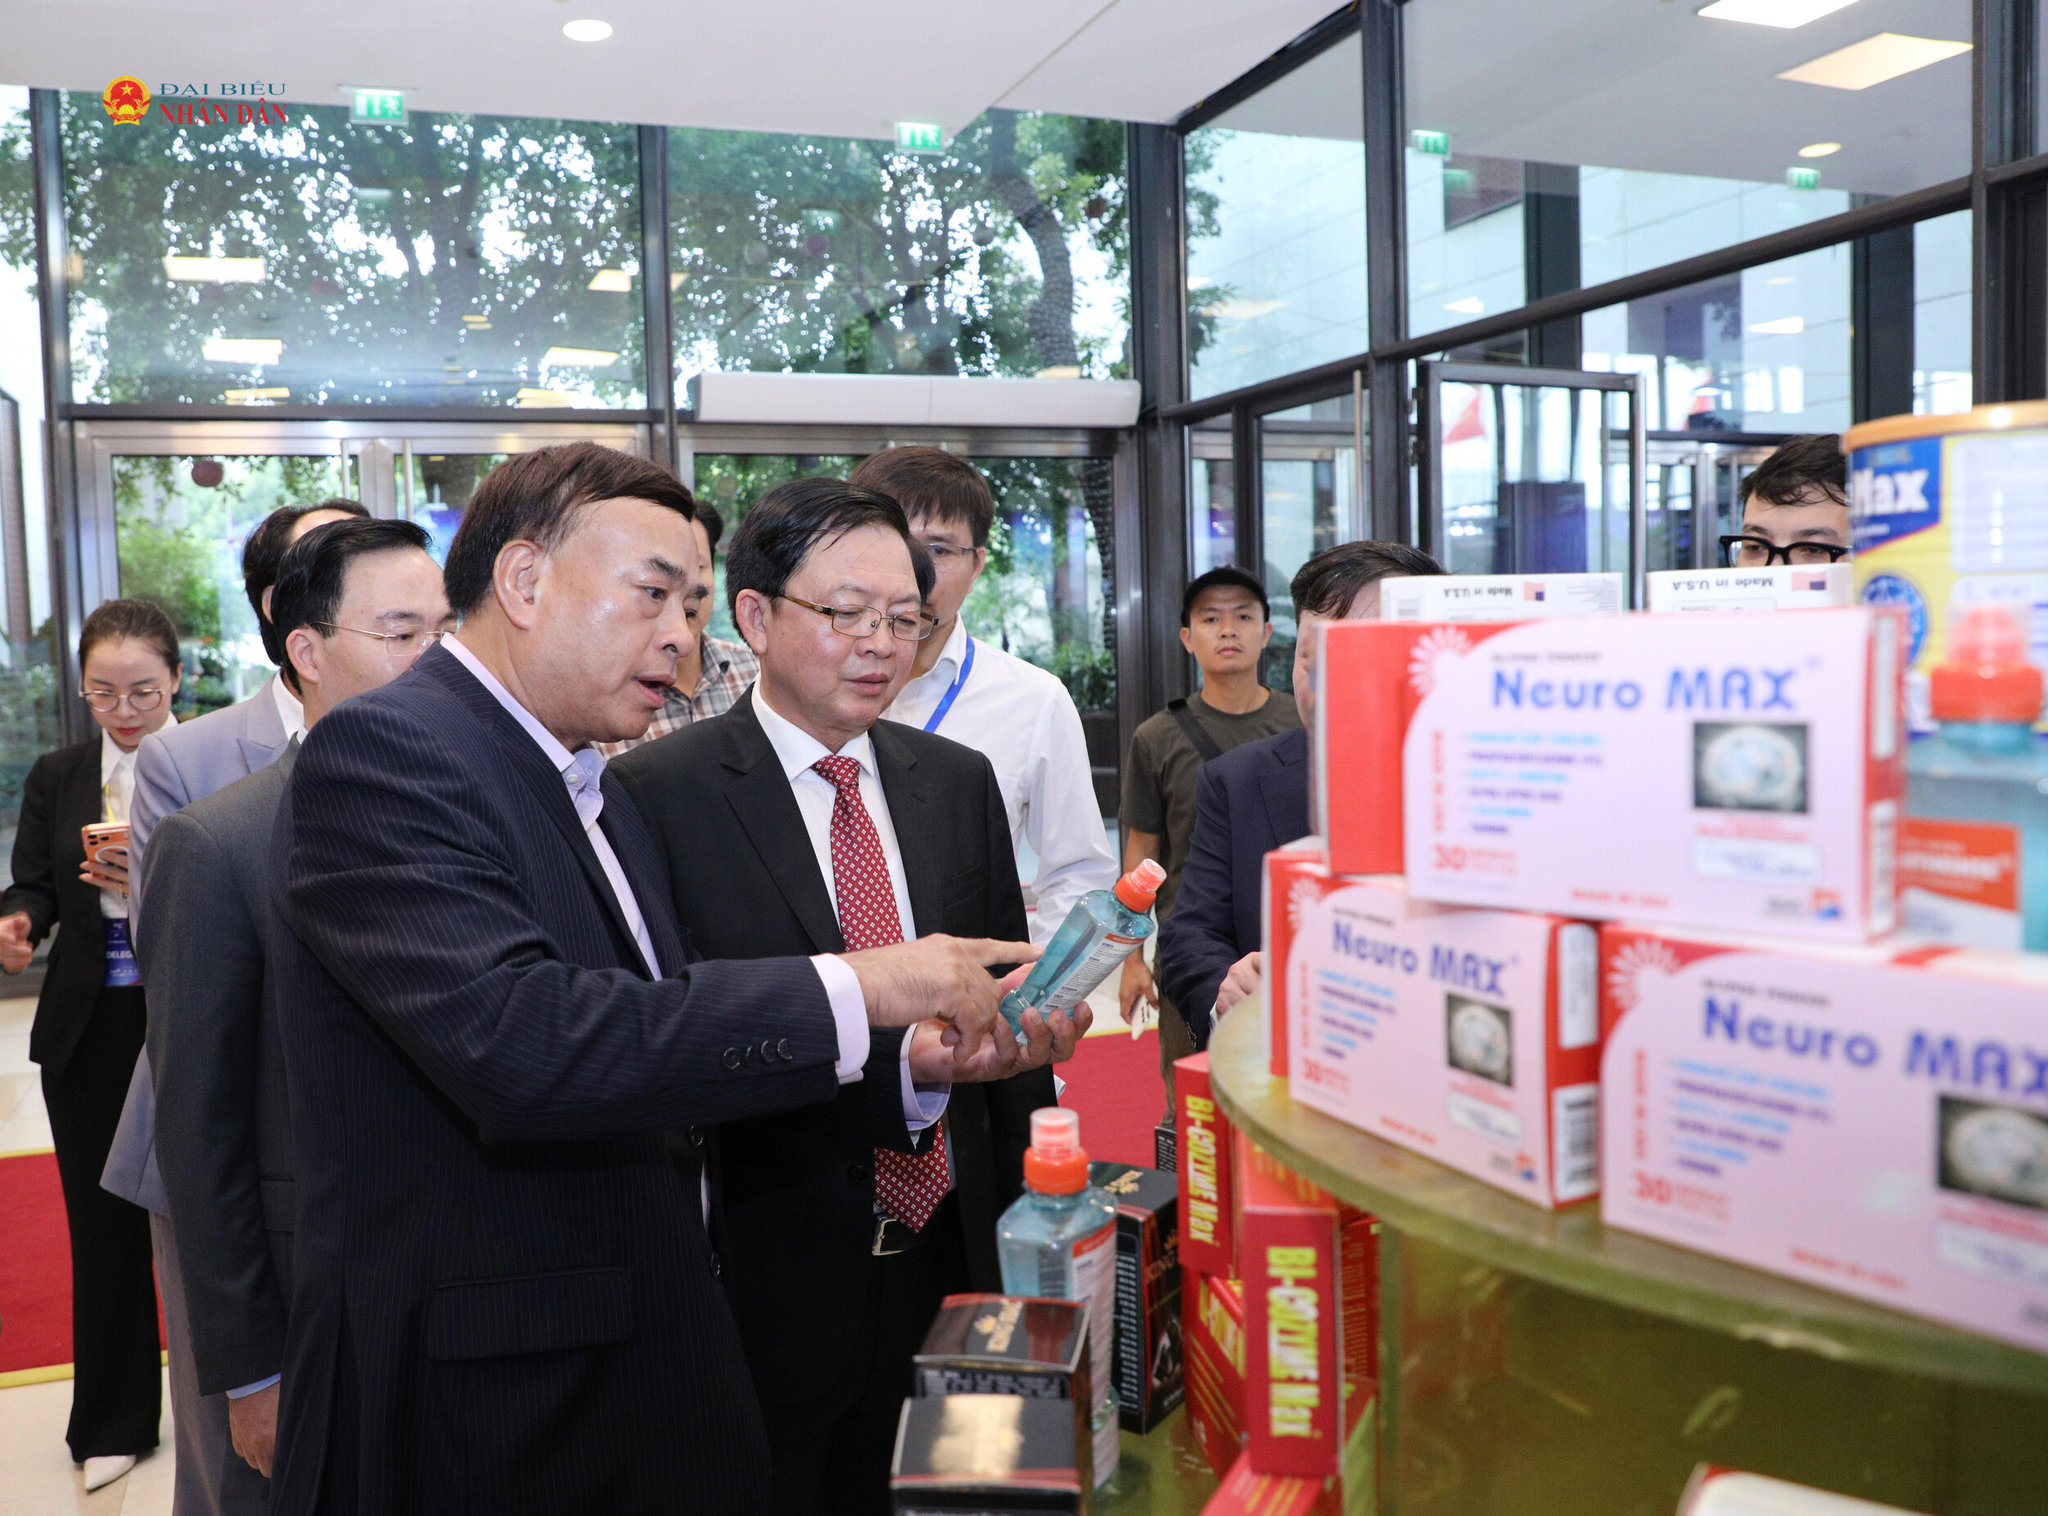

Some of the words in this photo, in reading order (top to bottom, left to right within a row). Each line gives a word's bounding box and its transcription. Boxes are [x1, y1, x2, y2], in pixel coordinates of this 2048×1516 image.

[1487, 586, 1513, 597] Made
[1715, 579, 1729, 588] in
[1735, 577, 1774, 588] Made
[1493, 669, 1642, 709] Neuro
[1665, 668, 1798, 710] MAX
[1332, 920, 1418, 974] Neuro
[1429, 944, 1505, 997] MAX
[1703, 995, 1879, 1068] Neuro
[1906, 1031, 2048, 1096] MAX
[1186, 1095, 1218, 1203] BI-COZYME
[1189, 1198, 1220, 1244] Max
[1266, 1246, 1319, 1381] BI-COZYME
[1270, 1382, 1320, 1436] Max
